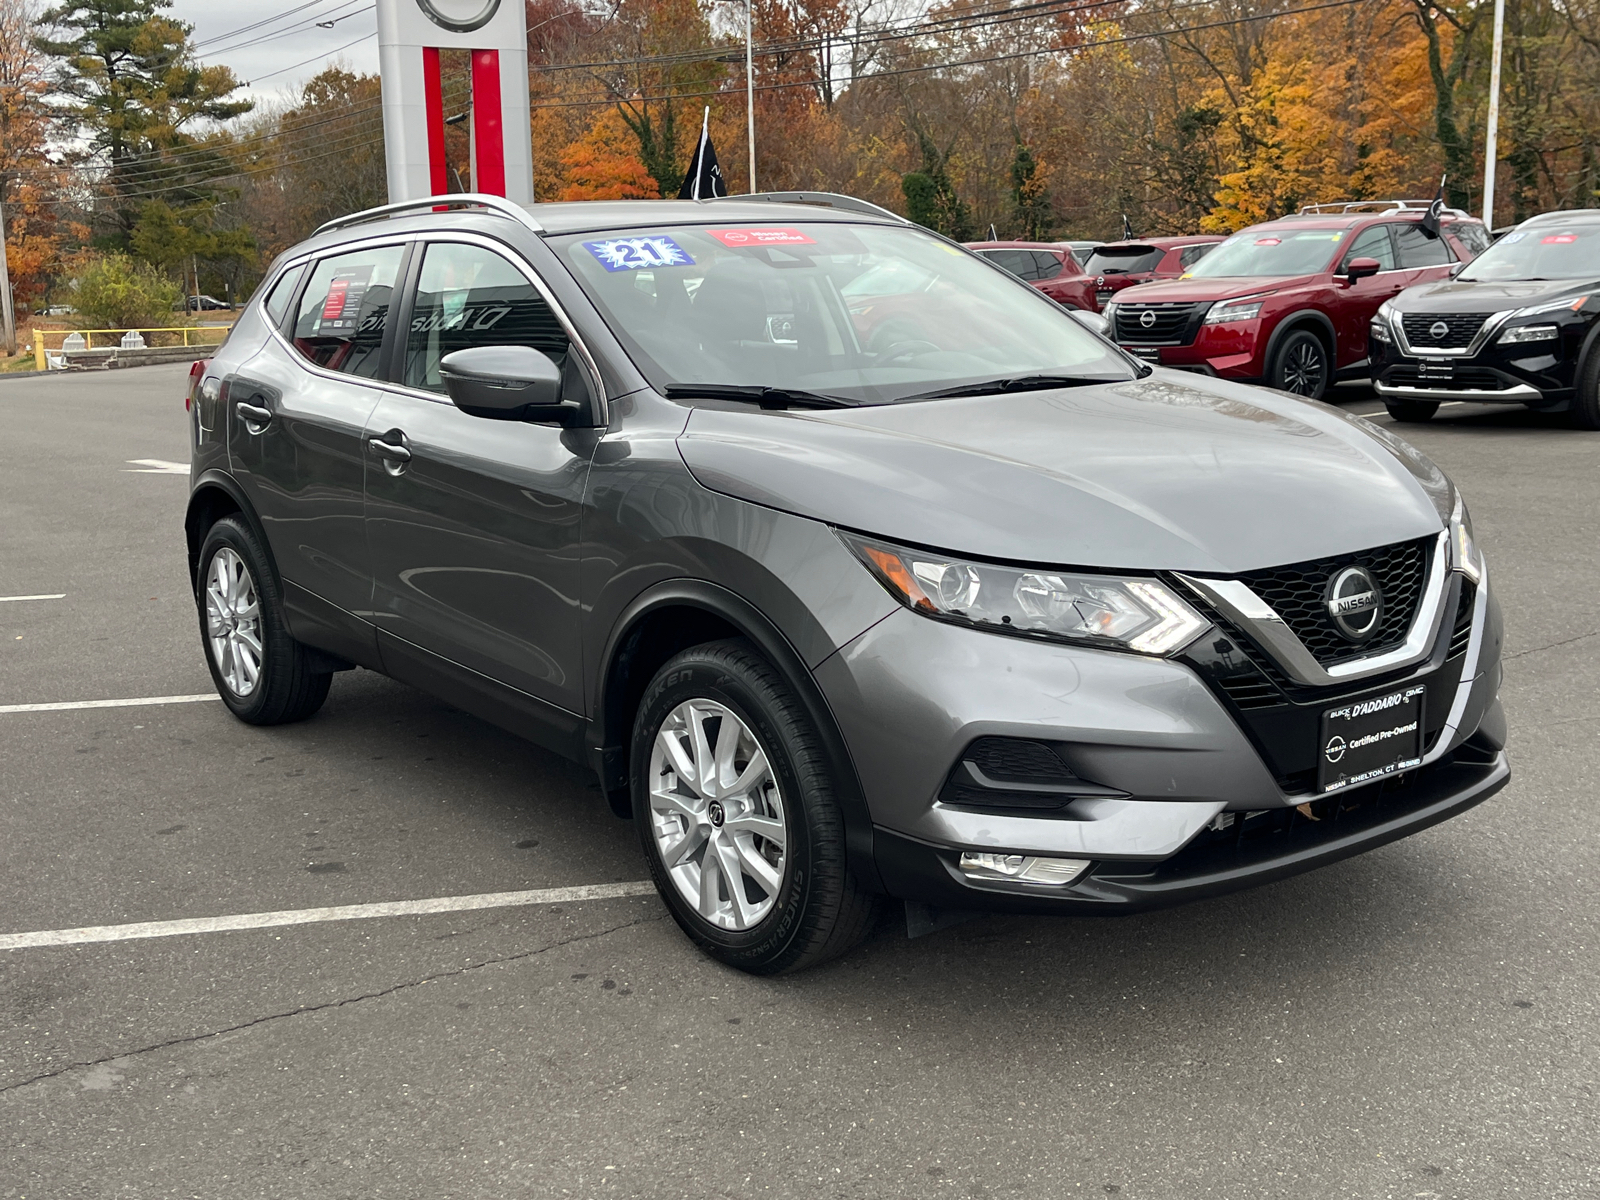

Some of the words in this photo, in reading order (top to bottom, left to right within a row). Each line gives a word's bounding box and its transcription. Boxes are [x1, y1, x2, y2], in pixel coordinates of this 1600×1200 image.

[615, 243, 664, 263] 21
[1338, 595, 1377, 612] NISSAN
[1330, 708, 1351, 718] BUICK
[1352, 694, 1402, 717] D'ADDARIO
[1406, 687, 1424, 697] GMC
[1349, 733, 1379, 748] Certified
[1380, 721, 1417, 740] Pre-Owned
[1325, 744, 1347, 754] NISSAN
[1325, 780, 1346, 792] NISSAN
[1350, 768, 1385, 783] SHELTON,
[1385, 764, 1395, 772] CT
